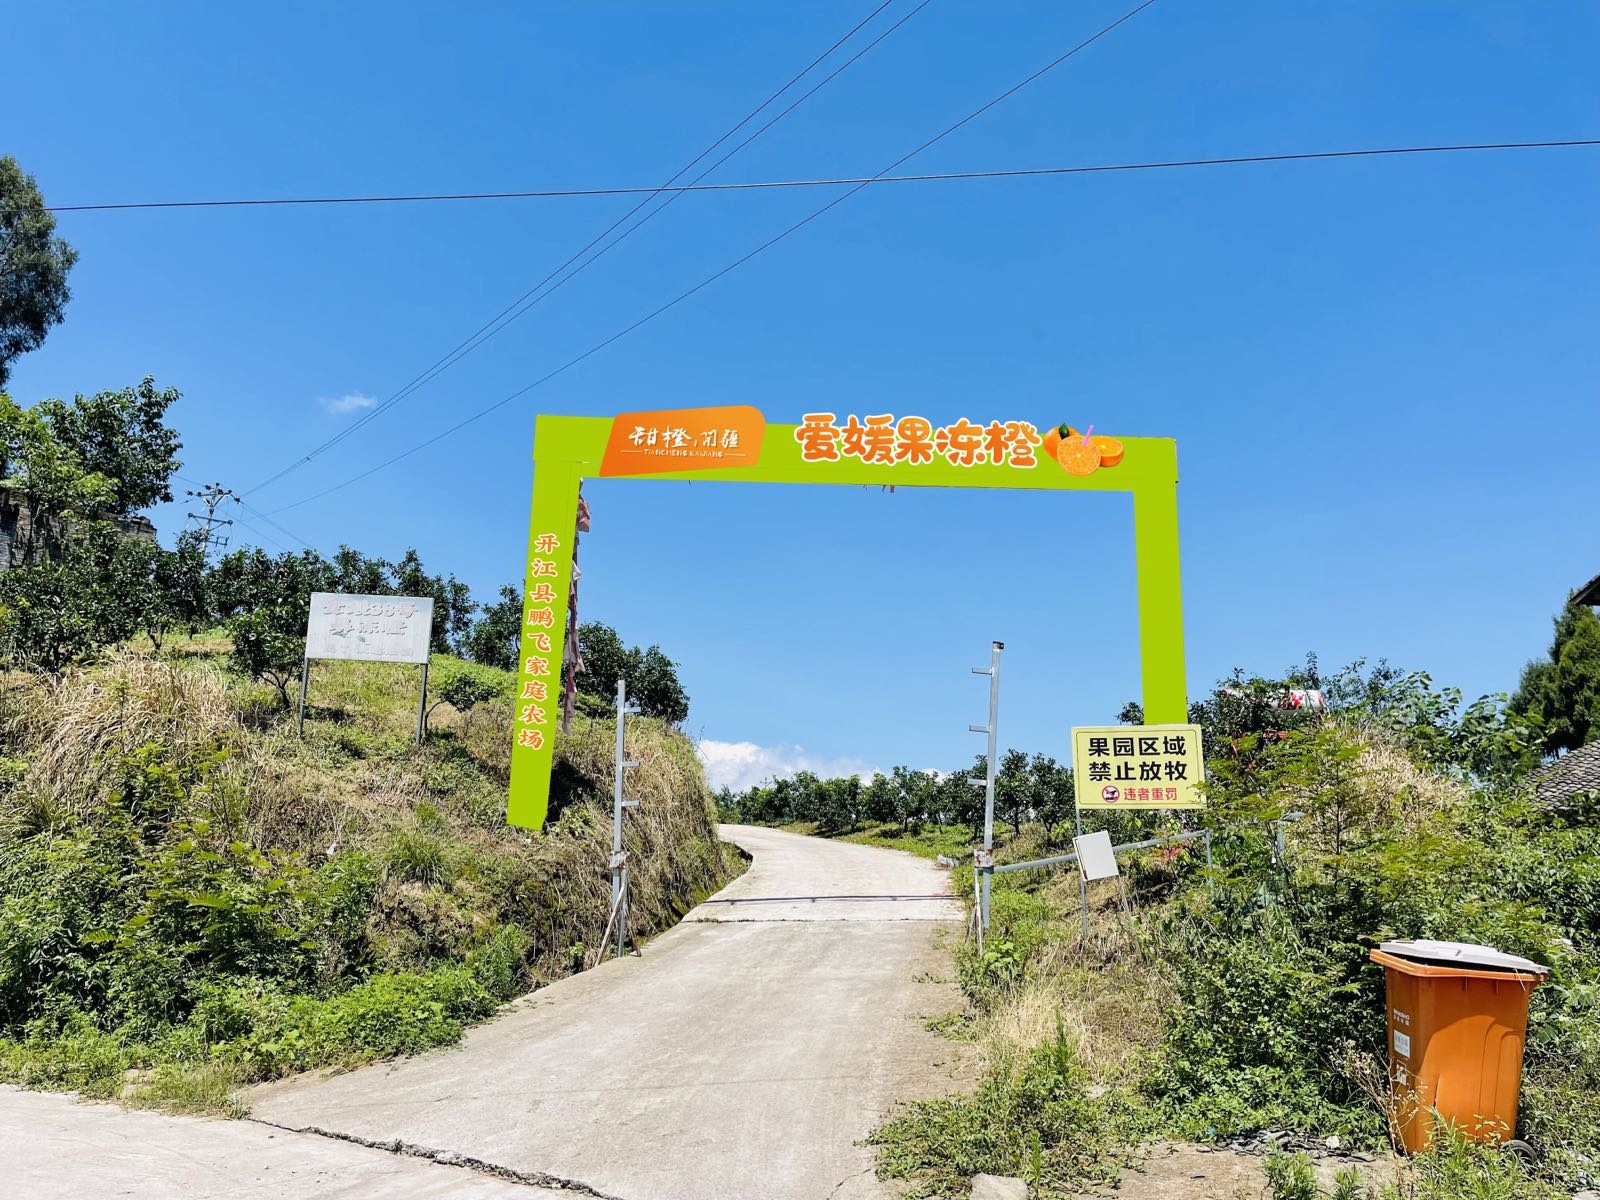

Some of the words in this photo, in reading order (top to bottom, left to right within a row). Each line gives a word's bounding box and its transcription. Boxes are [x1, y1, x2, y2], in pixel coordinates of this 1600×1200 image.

[795, 413, 1042, 469] 爱媛果冻橙
[643, 448, 688, 457] TIANCHENG
[689, 450, 724, 458] KAIJIANG
[518, 533, 560, 750] 开江县鹏飞家庭农场
[1088, 736, 1186, 757] 果园区域
[1089, 761, 1187, 781] 禁止放牧
[1124, 787, 1177, 801] 违者重罚
